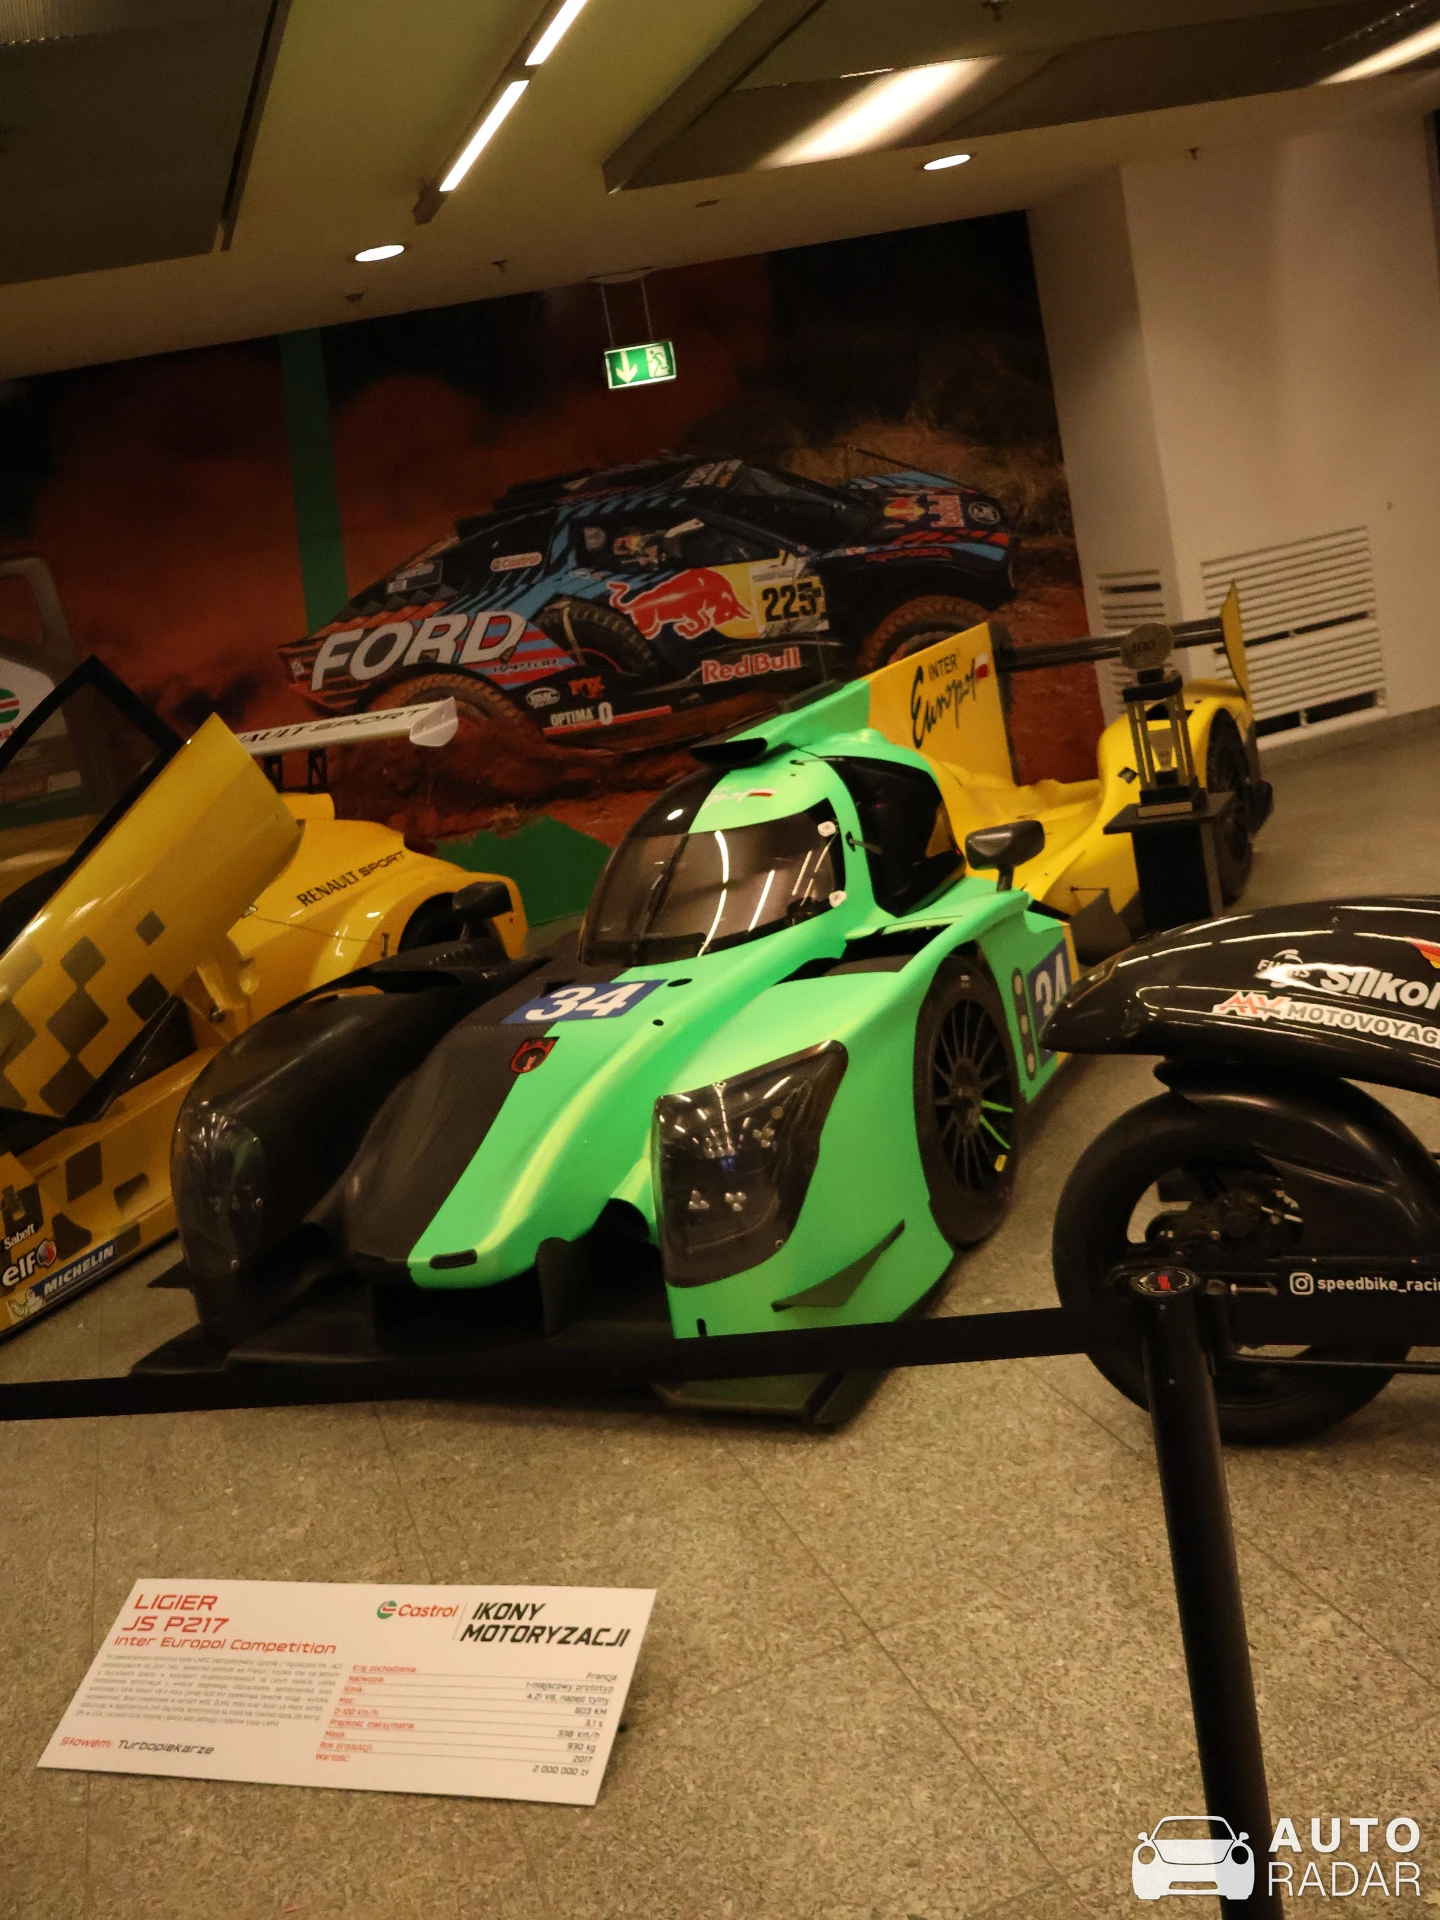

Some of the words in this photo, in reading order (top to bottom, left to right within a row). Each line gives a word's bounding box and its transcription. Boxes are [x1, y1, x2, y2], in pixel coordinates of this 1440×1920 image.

[311, 610, 529, 691] FORD
[702, 657, 750, 684] Red
[752, 647, 800, 677] Bull
[928, 653, 957, 682] INTER
[550, 707, 595, 727] OPTIMA
[296, 870, 359, 907] RENAULT
[358, 850, 404, 876] SPORT
[525, 982, 646, 1021] 34
[2, 1250, 37, 1287] elf
[44, 1244, 114, 1295] MICHELIN
[1317, 1276, 1440, 1294] speedbike_raci
[134, 1594, 218, 1611] LIGIER
[398, 1603, 459, 1618] Castrol
[471, 1602, 546, 1621] IKONY
[121, 1615, 158, 1632] JS
[163, 1616, 230, 1633] P217
[113, 1635, 156, 1647] Inter
[160, 1637, 227, 1651] Europol
[229, 1638, 337, 1655] Competition
[460, 1624, 632, 1647] MOTORYZACJI
[118, 1739, 215, 1756] Turbopiekarze
